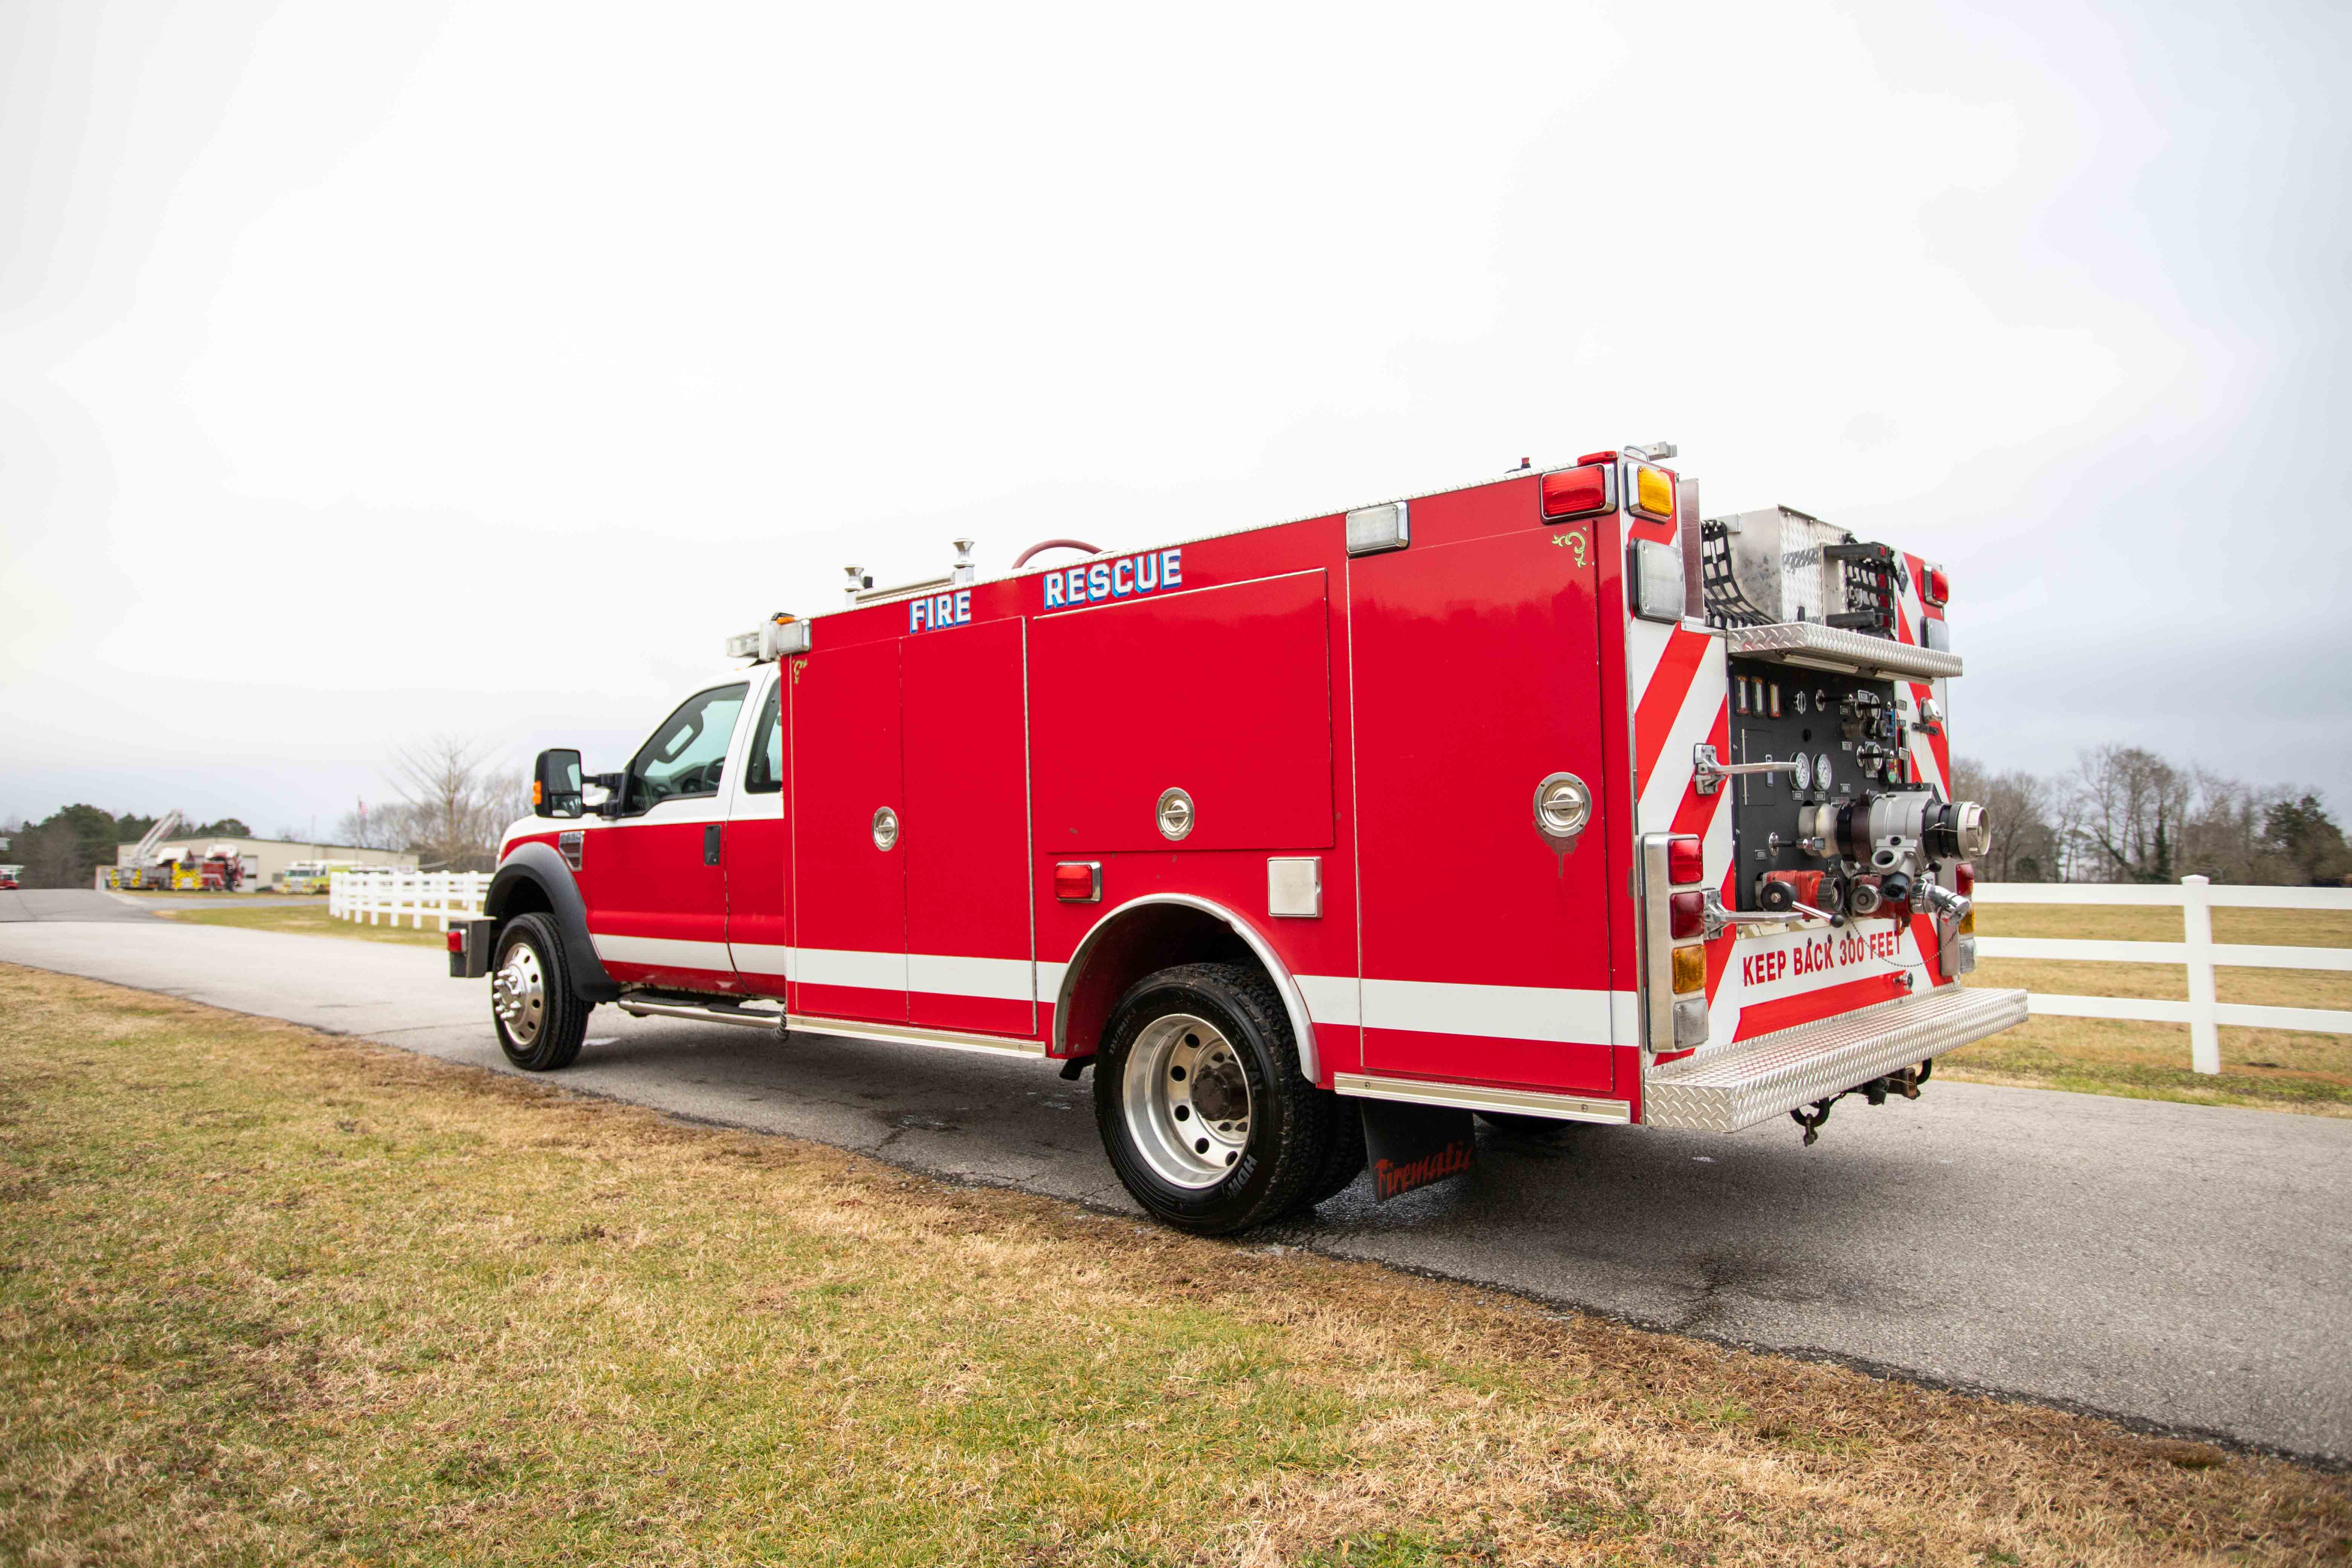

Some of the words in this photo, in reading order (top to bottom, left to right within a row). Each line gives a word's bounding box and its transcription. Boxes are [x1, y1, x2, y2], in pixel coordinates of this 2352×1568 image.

[910, 590, 971, 634] FIRE
[1044, 548, 1182, 610] RESCUE
[1743, 950, 1786, 987] KEEP
[1793, 941, 1834, 975] BACK
[1840, 936, 1864, 966] 300
[1870, 931, 1900, 960] FEET
[1374, 1140, 1473, 1201] Firematic
